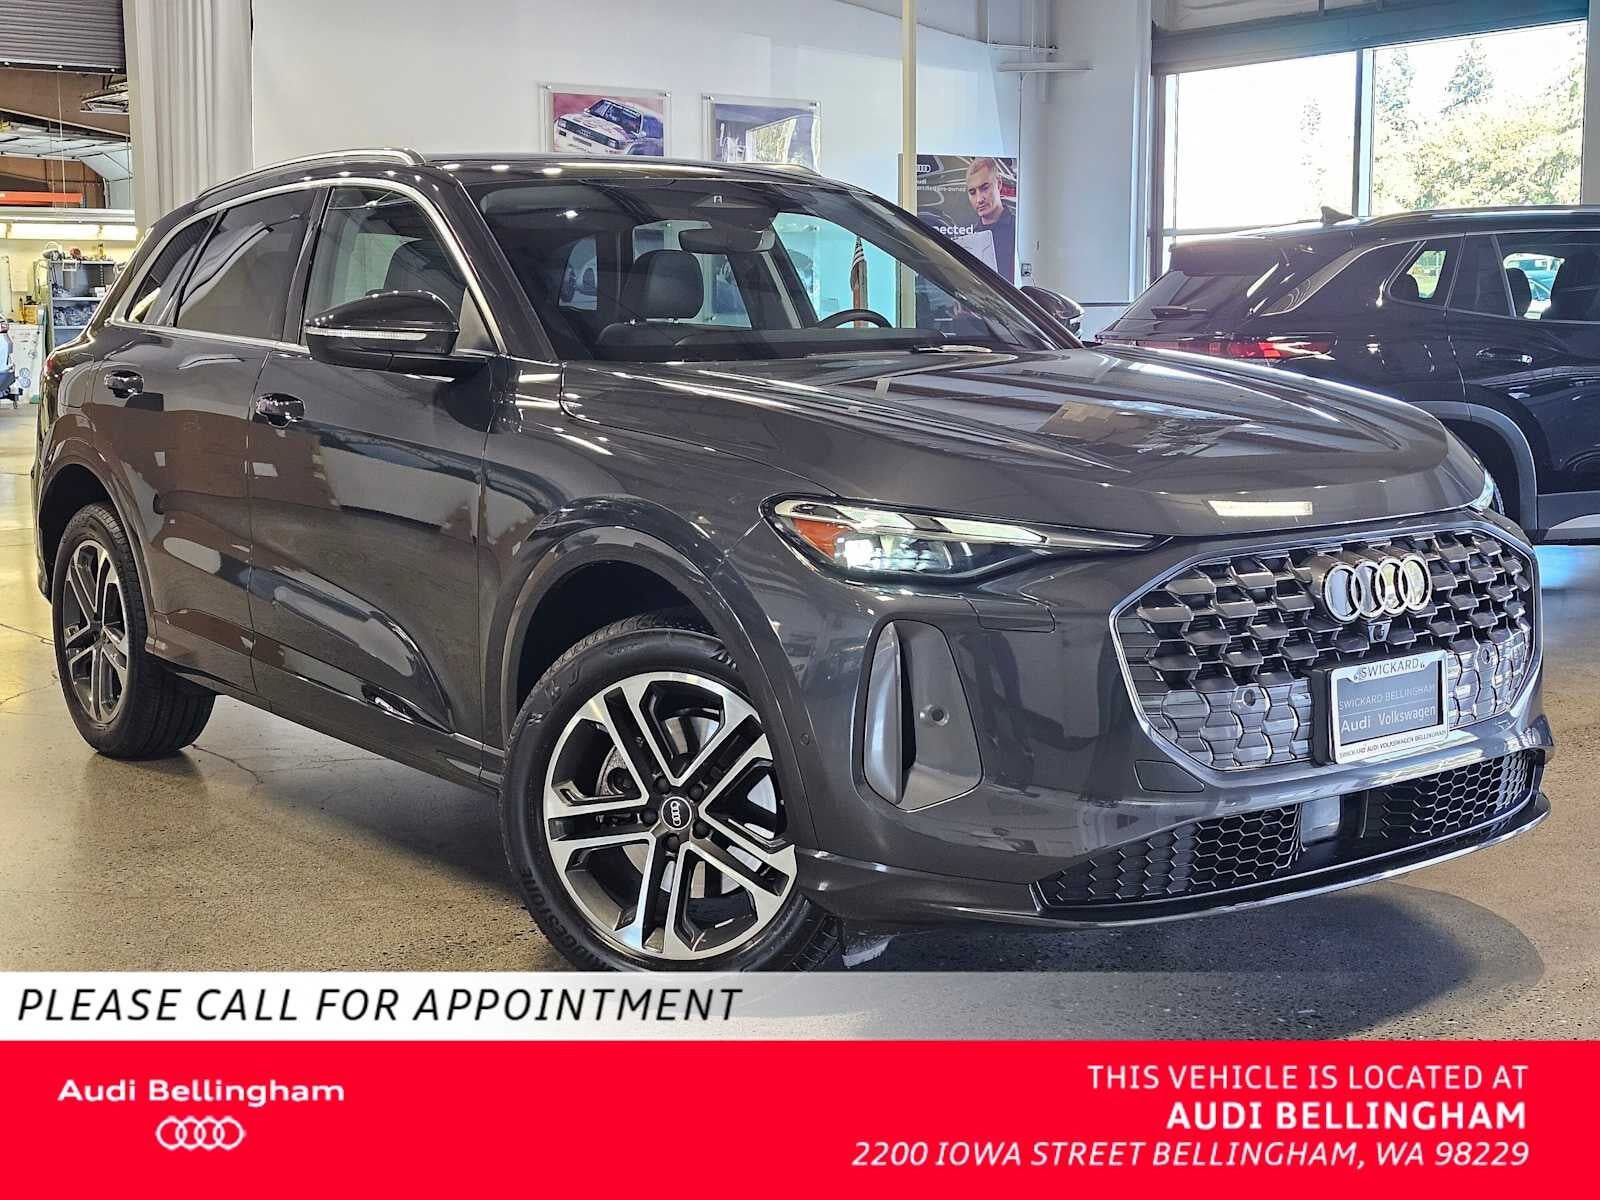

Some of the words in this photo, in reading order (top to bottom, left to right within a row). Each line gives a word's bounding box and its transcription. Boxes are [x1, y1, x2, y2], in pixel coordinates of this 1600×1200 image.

[1361, 658, 1419, 678] SWICKARD
[1339, 694, 1383, 711] SWICKARD
[1385, 683, 1435, 702] BELLINGHAM
[1340, 716, 1371, 734] Audi
[1377, 705, 1436, 727] Volkswagen
